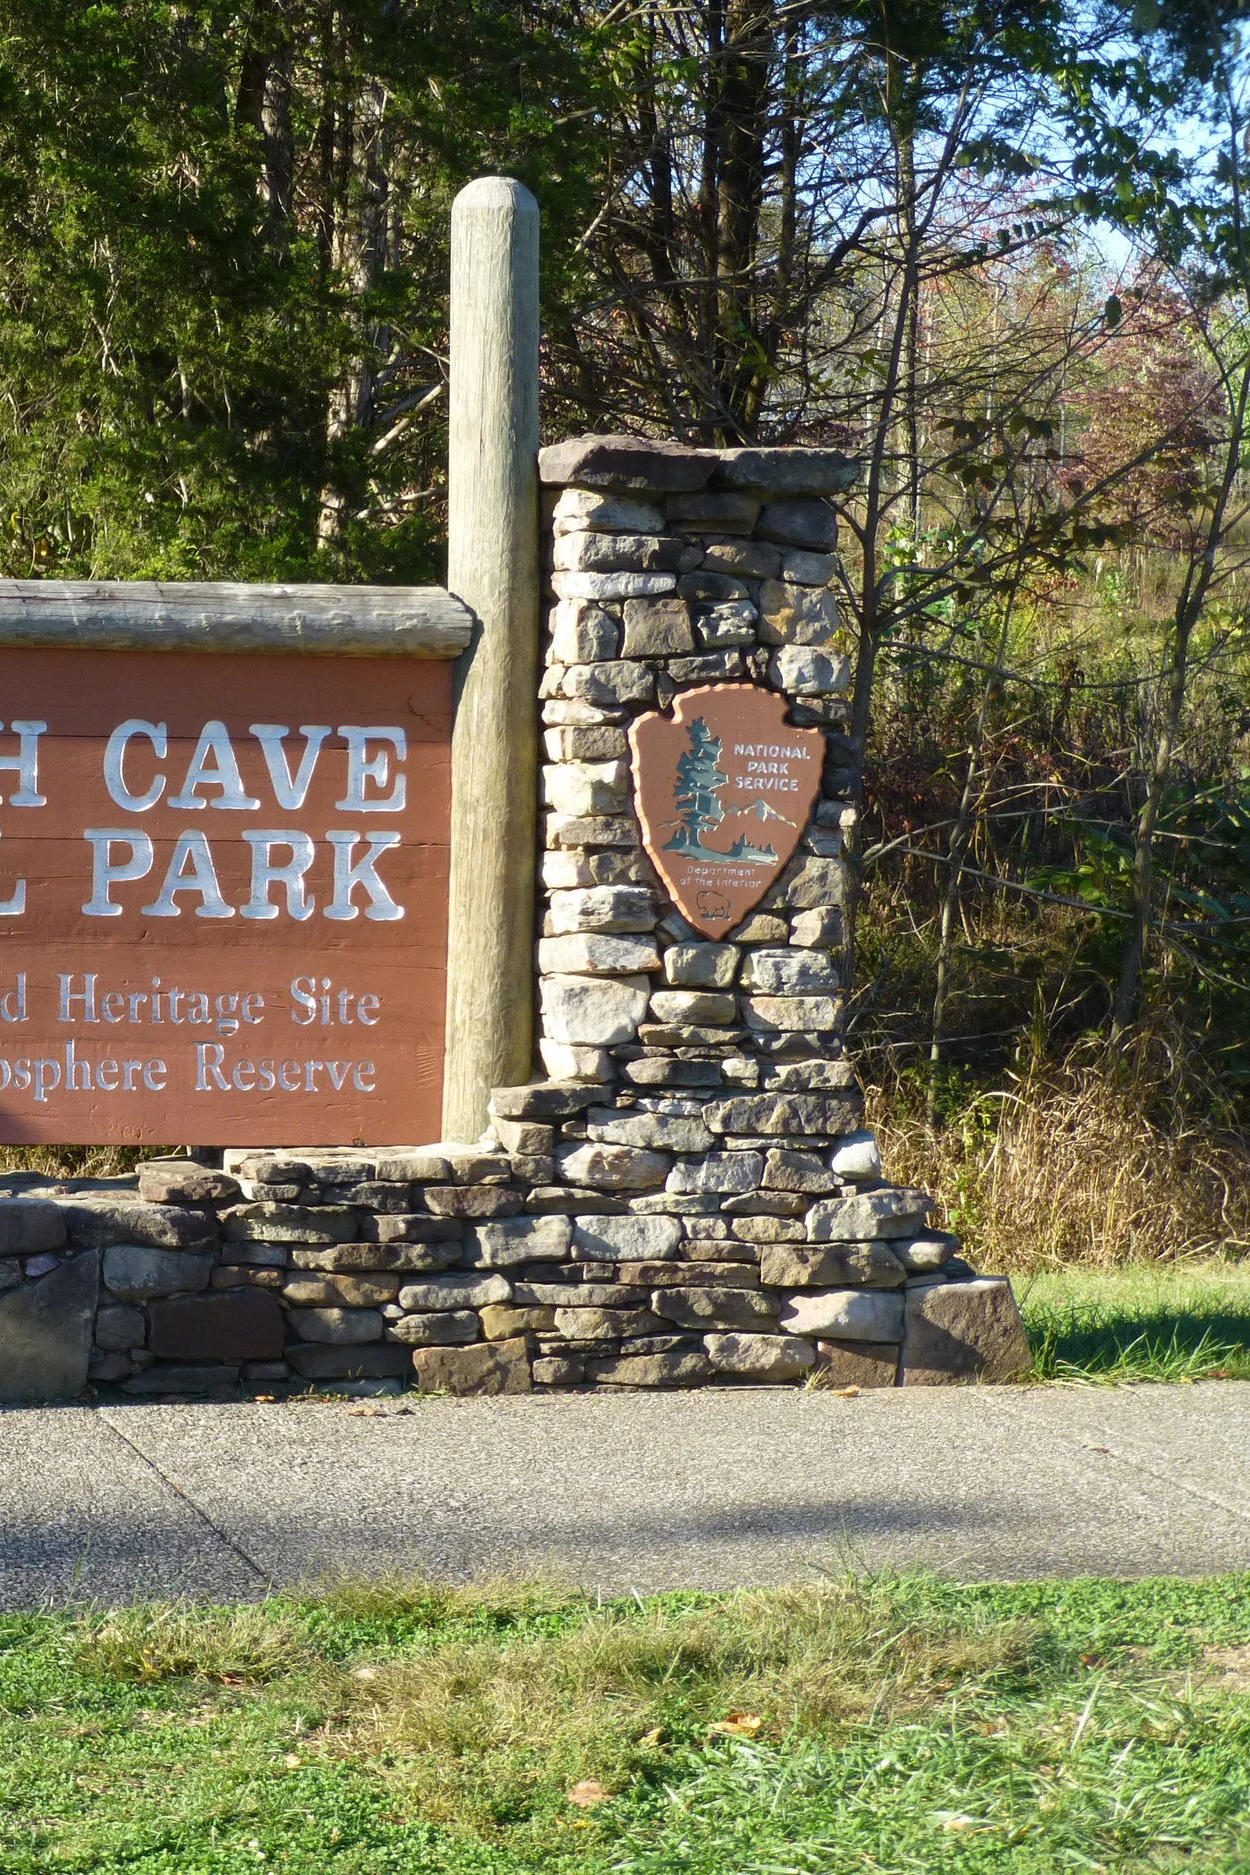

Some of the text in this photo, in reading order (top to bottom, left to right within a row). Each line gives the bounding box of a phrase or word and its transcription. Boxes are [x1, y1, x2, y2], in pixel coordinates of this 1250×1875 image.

[734, 744, 810, 759] NATIONAL
[103, 719, 407, 812] CAVE
[747, 761, 789, 774] PARK
[735, 776, 798, 791] SERVICE
[81, 829, 405, 920] PARK
[687, 865, 756, 876] Department
[695, 877, 713, 887] the
[716, 878, 762, 888] Interior
[57, 973, 265, 1036] Heritage
[290, 975, 380, 1026] Site
[192, 1041, 376, 1092] Reserve
